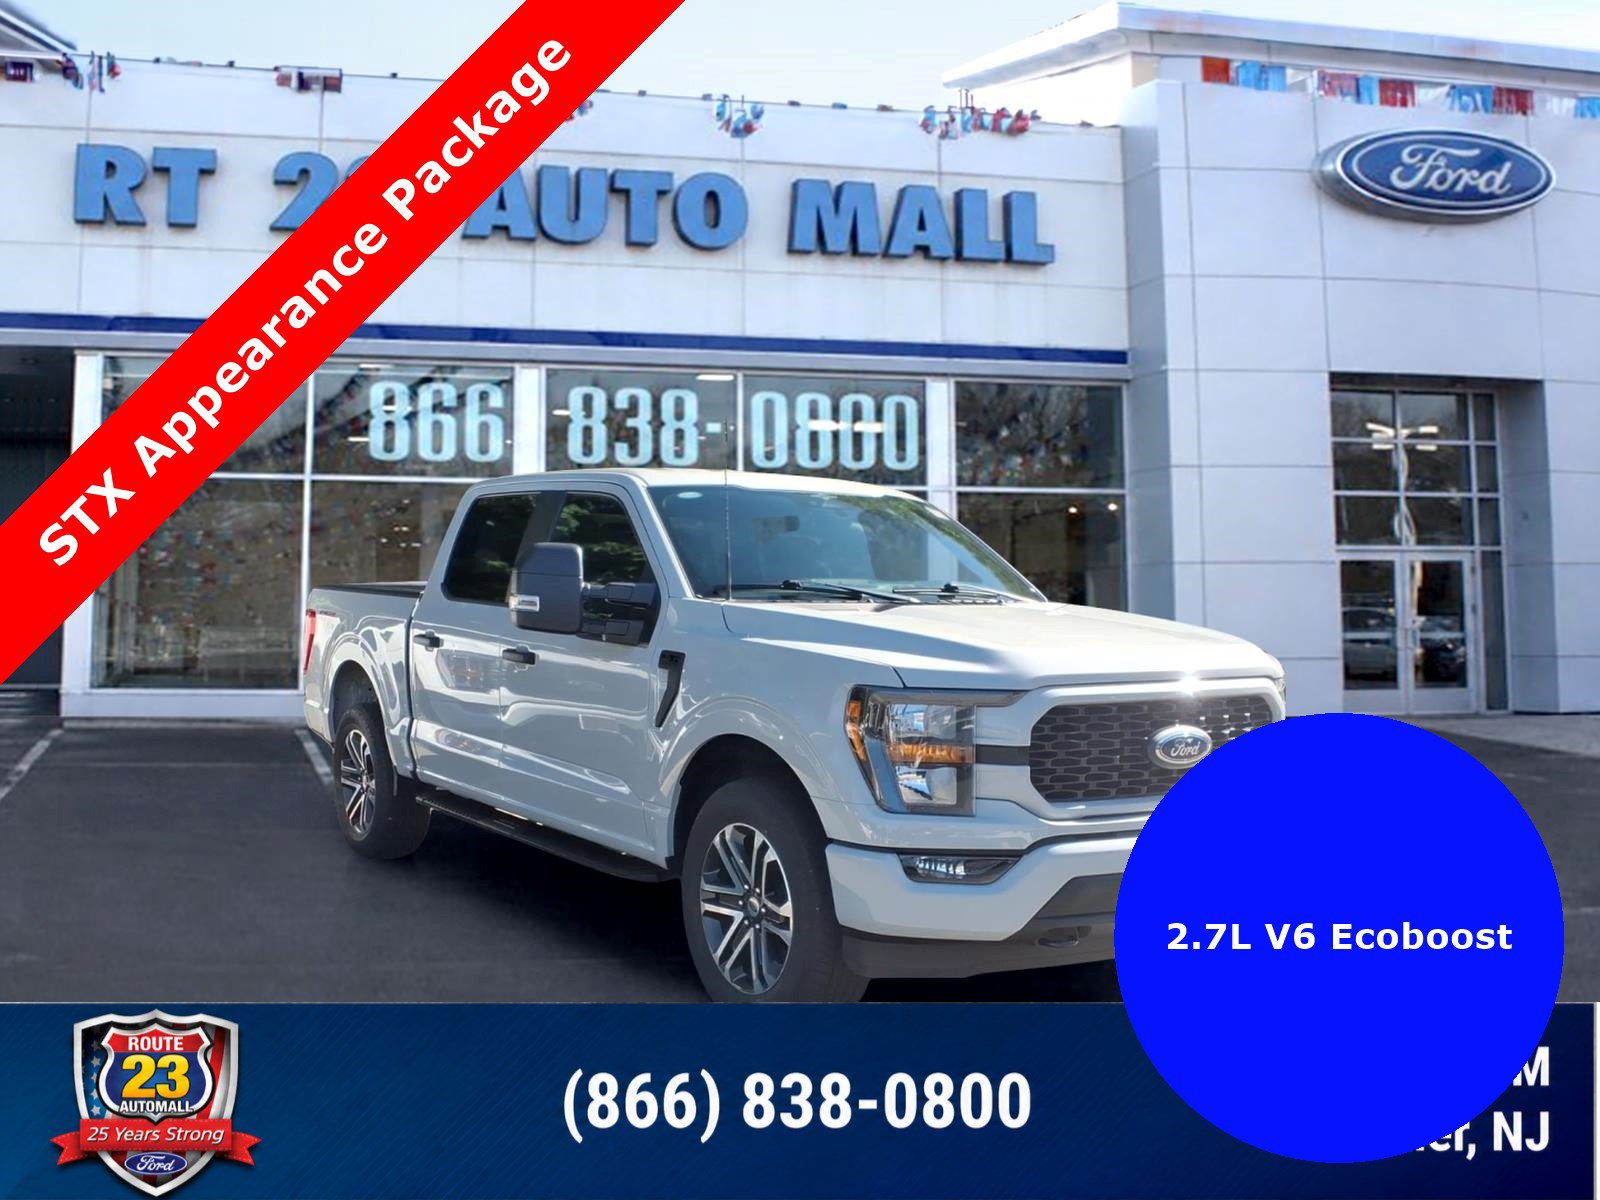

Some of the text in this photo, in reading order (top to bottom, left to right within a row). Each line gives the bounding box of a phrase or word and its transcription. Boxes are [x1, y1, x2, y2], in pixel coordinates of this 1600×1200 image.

[1391, 143, 1512, 194] Ford
[73, 143, 1056, 265] RT 2 AUTO MALL
[369, 380, 504, 463] 866
[1170, 737, 1200, 757] Ford
